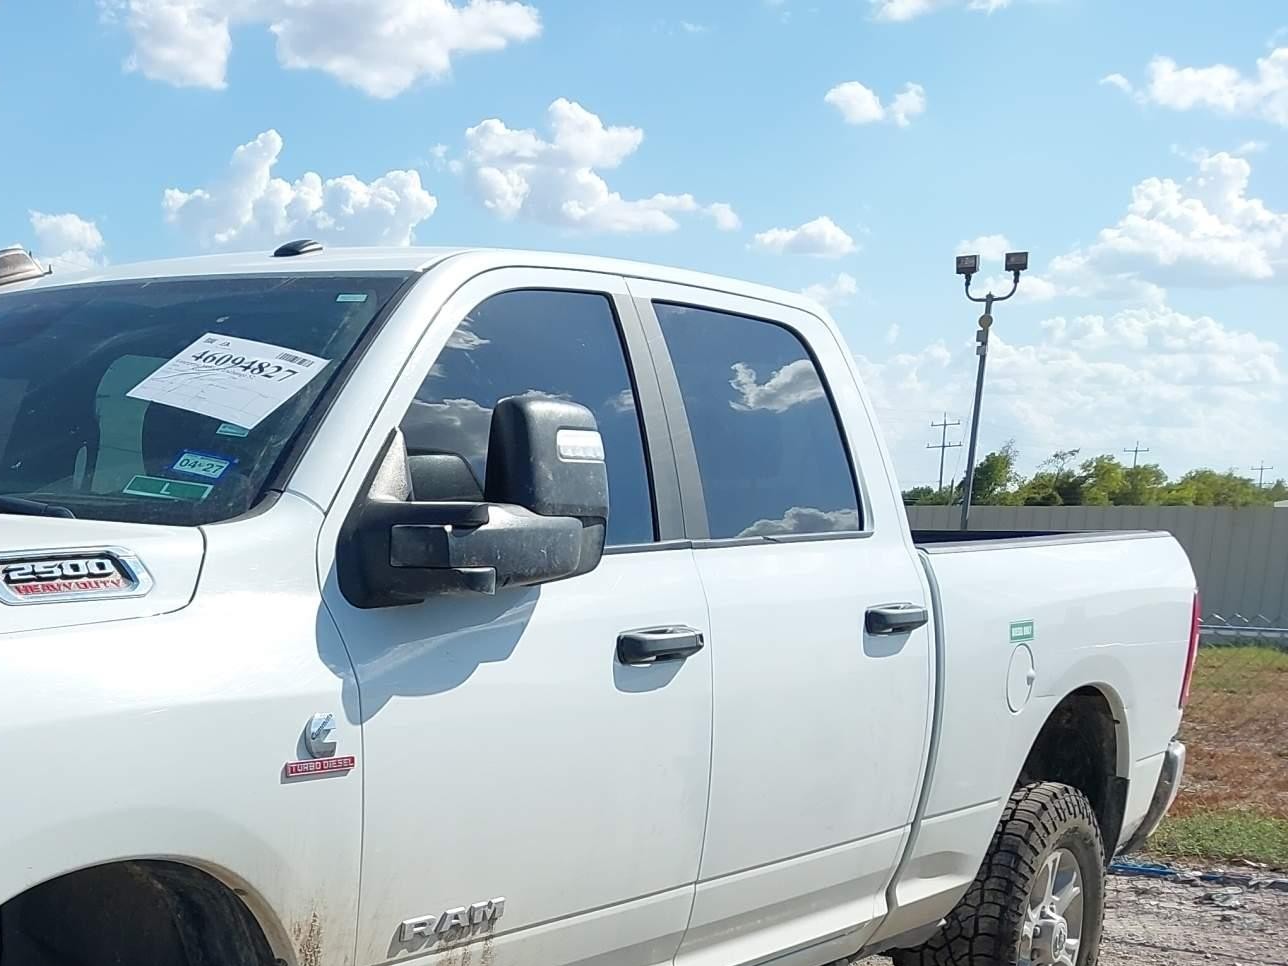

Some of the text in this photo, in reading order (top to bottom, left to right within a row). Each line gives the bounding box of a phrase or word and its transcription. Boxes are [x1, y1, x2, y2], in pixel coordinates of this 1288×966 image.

[192, 350, 299, 382] 46094827
[179, 458, 225, 474] 04 27
[4, 559, 114, 582] 2500
[15, 578, 121, 595] HEAVY DUTY
[288, 758, 355, 775] TURBO DIESEL
[392, 896, 505, 948] RAM
